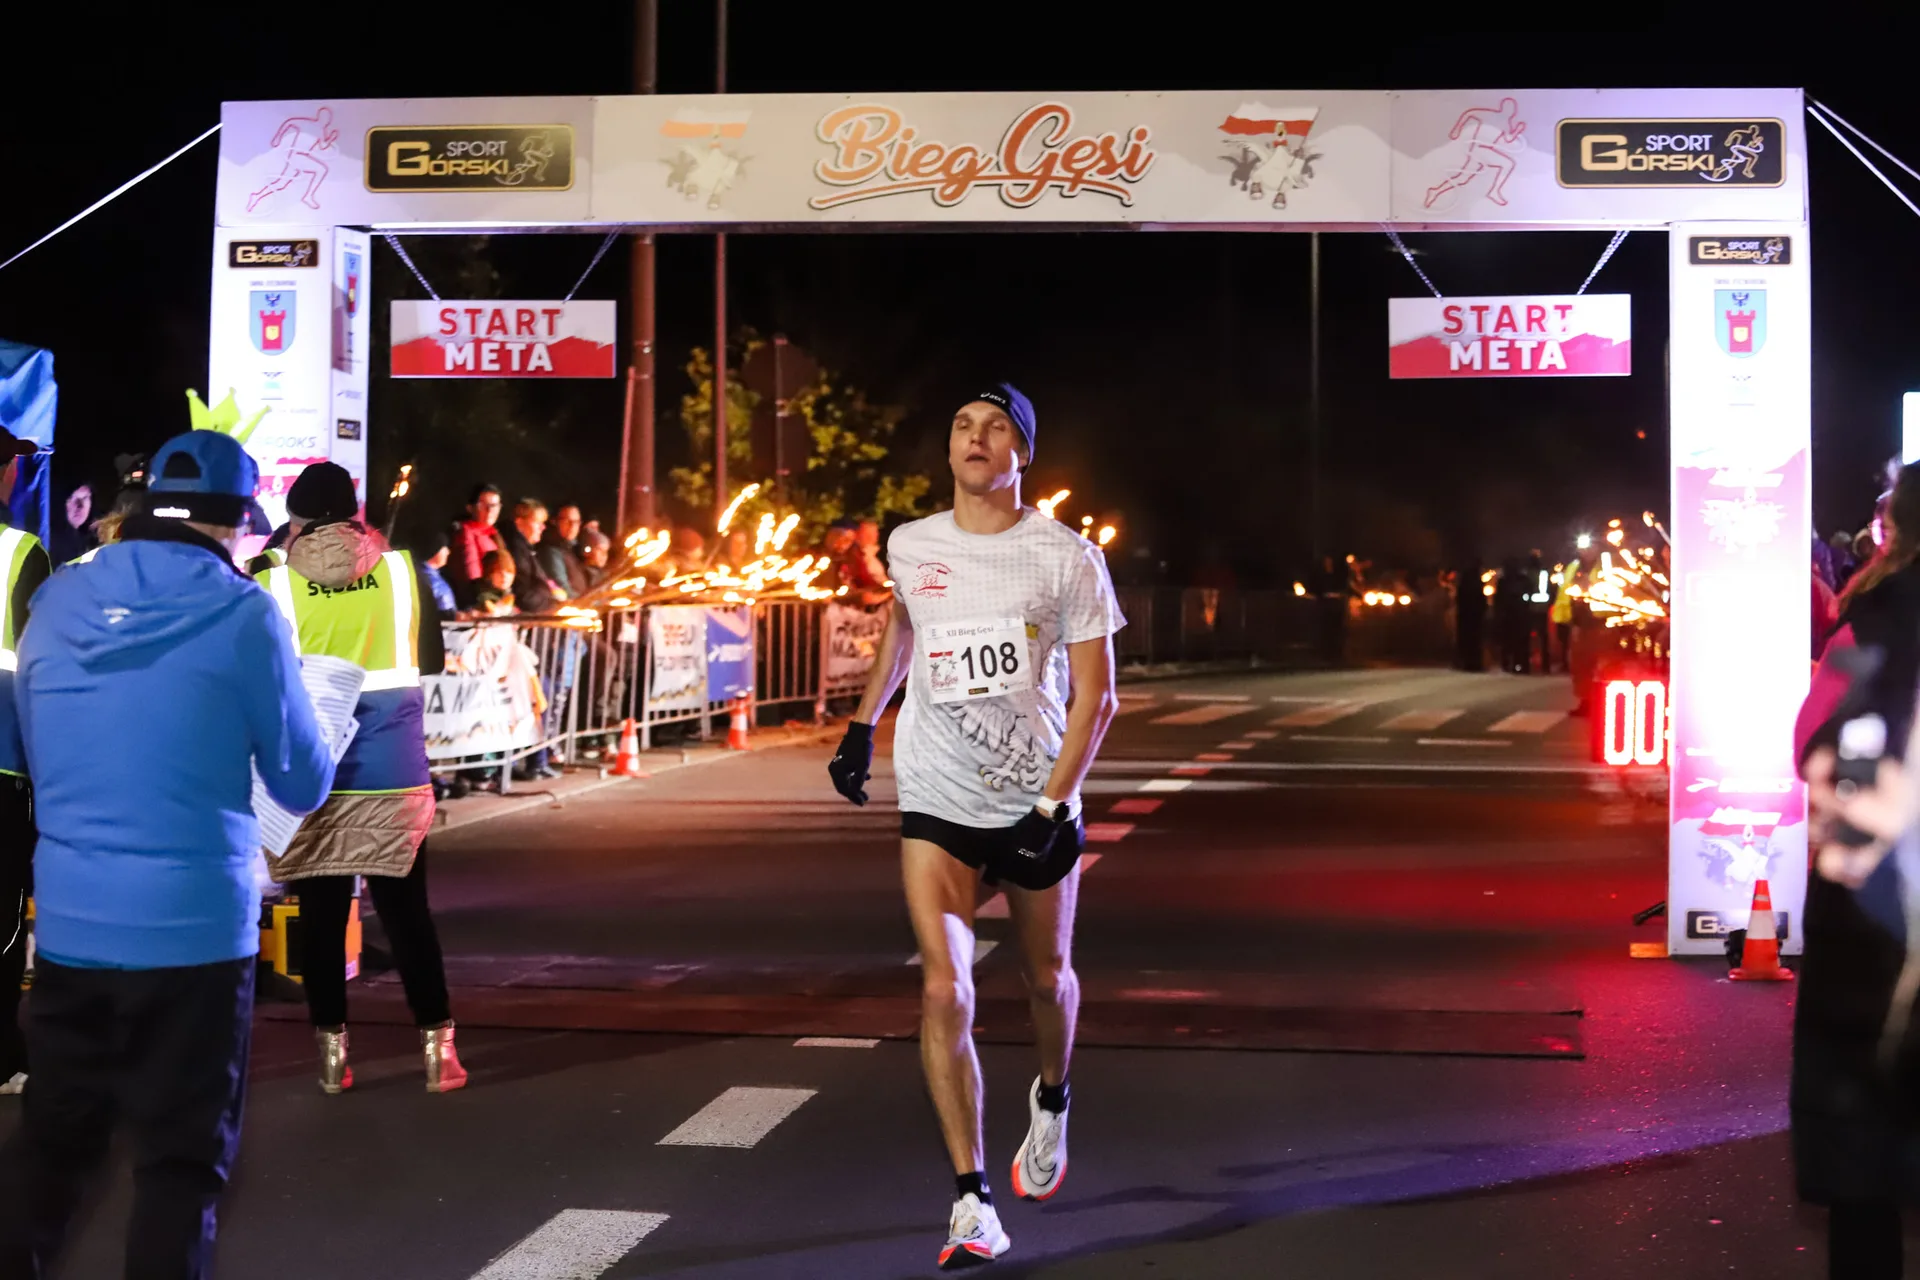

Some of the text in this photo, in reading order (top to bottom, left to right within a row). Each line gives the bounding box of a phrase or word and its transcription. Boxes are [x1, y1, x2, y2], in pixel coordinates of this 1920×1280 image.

[446, 140, 508, 157] SPORT
[819, 104, 1154, 203] Bieg Gęsi
[1581, 134, 1715, 171] GÓRSKI
[1645, 134, 1713, 152] SPORT
[387, 141, 509, 176] GÓRSKI
[1727, 241, 1761, 250] SPORT
[440, 307, 562, 336] START
[1442, 304, 1573, 334] START
[445, 342, 554, 372] META
[1449, 339, 1568, 371] META
[958, 628, 976, 637] Bieg
[960, 641, 1019, 680] 108
